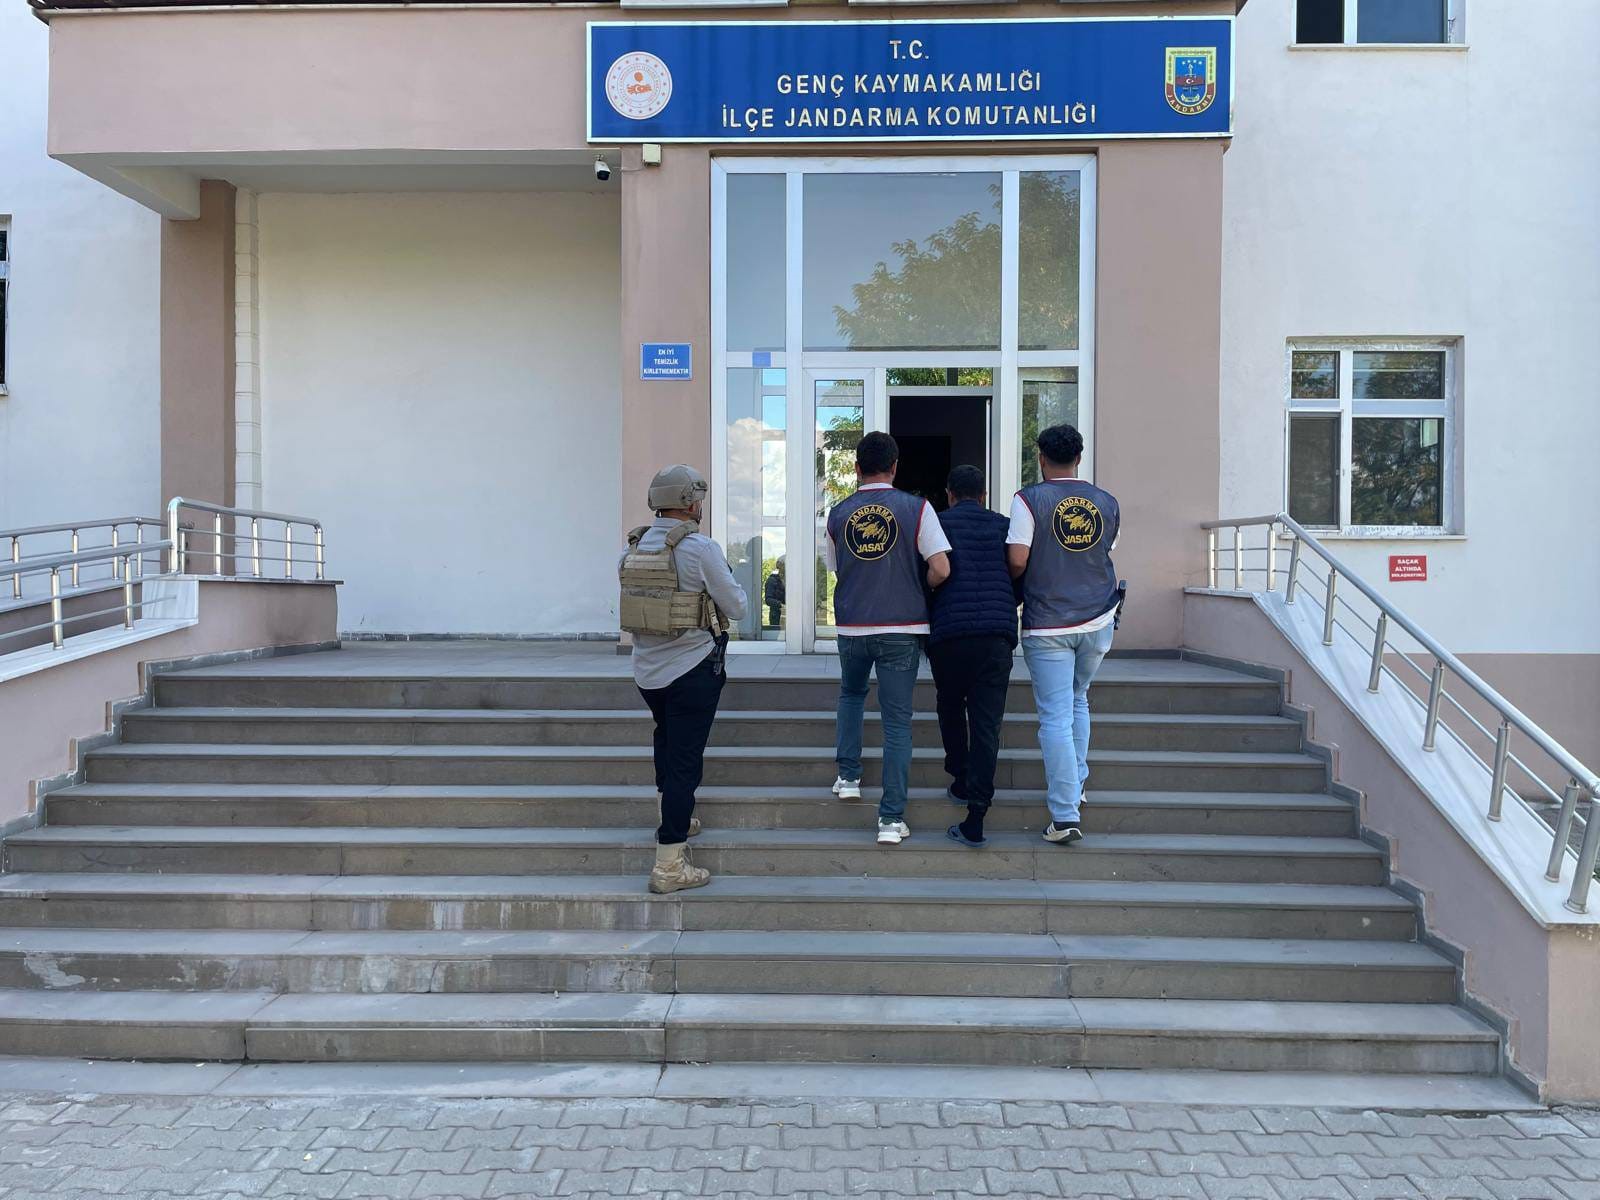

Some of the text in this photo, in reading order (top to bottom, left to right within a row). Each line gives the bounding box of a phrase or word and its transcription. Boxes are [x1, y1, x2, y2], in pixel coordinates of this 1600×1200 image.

[889, 40, 929, 59] T.C.
[777, 69, 1041, 98] GENÇ KAYMAKAMLIĞI
[722, 101, 1096, 131] İLÇE JANDARMA KOMUTANLIĞI
[1057, 498, 1098, 516] JANDARMA
[850, 506, 893, 528] JANDARMA
[857, 543, 886, 553] JASAT
[1064, 535, 1093, 544] JASAT
